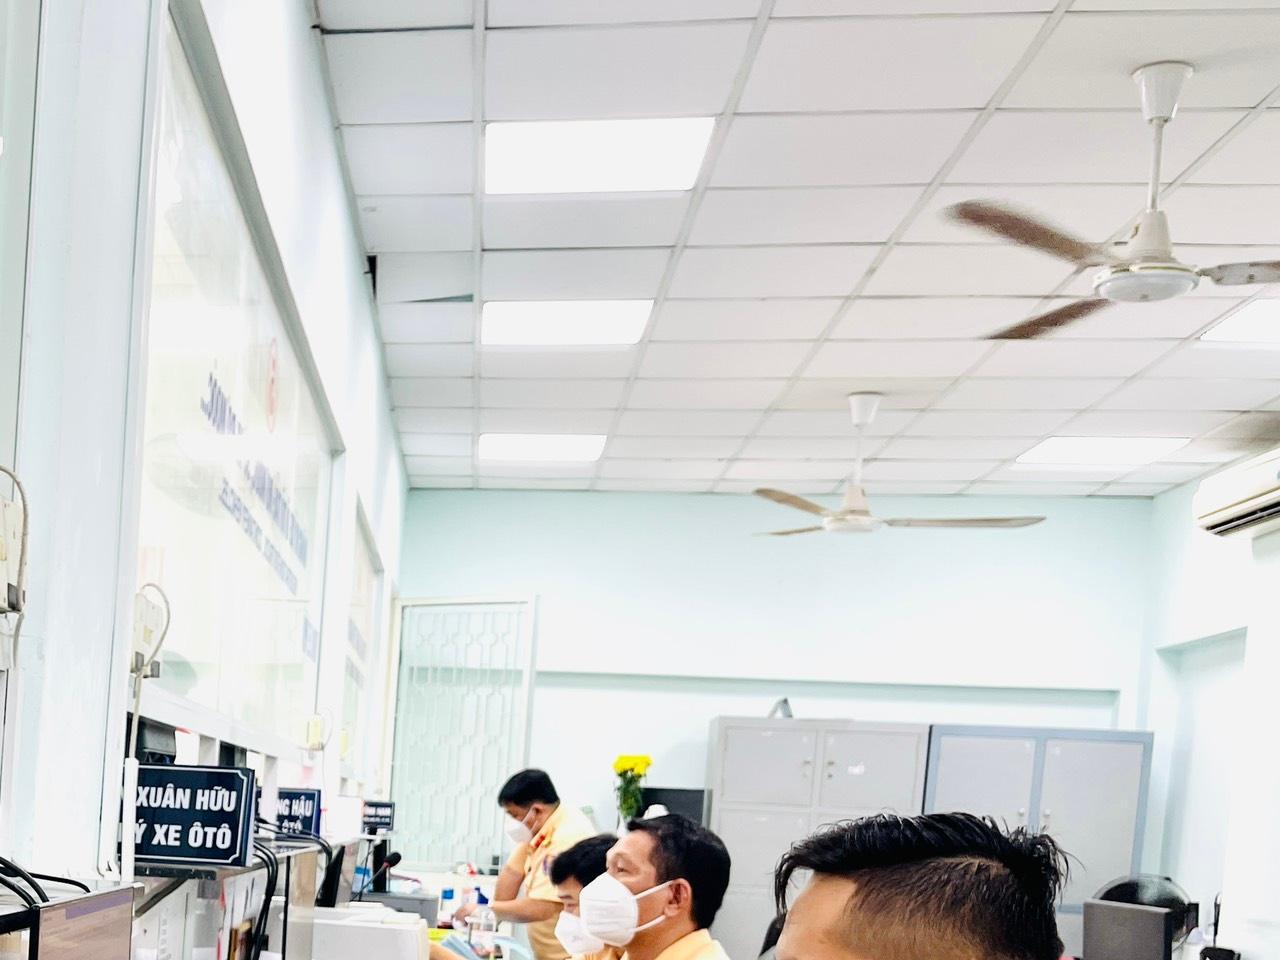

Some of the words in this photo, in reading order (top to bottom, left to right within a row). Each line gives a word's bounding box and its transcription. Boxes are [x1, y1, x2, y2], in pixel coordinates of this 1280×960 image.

[136, 783, 191, 809] XUÂN
[195, 785, 237, 812] HỮU
[151, 823, 182, 846] XE
[188, 822, 232, 849] ÔTÔ
